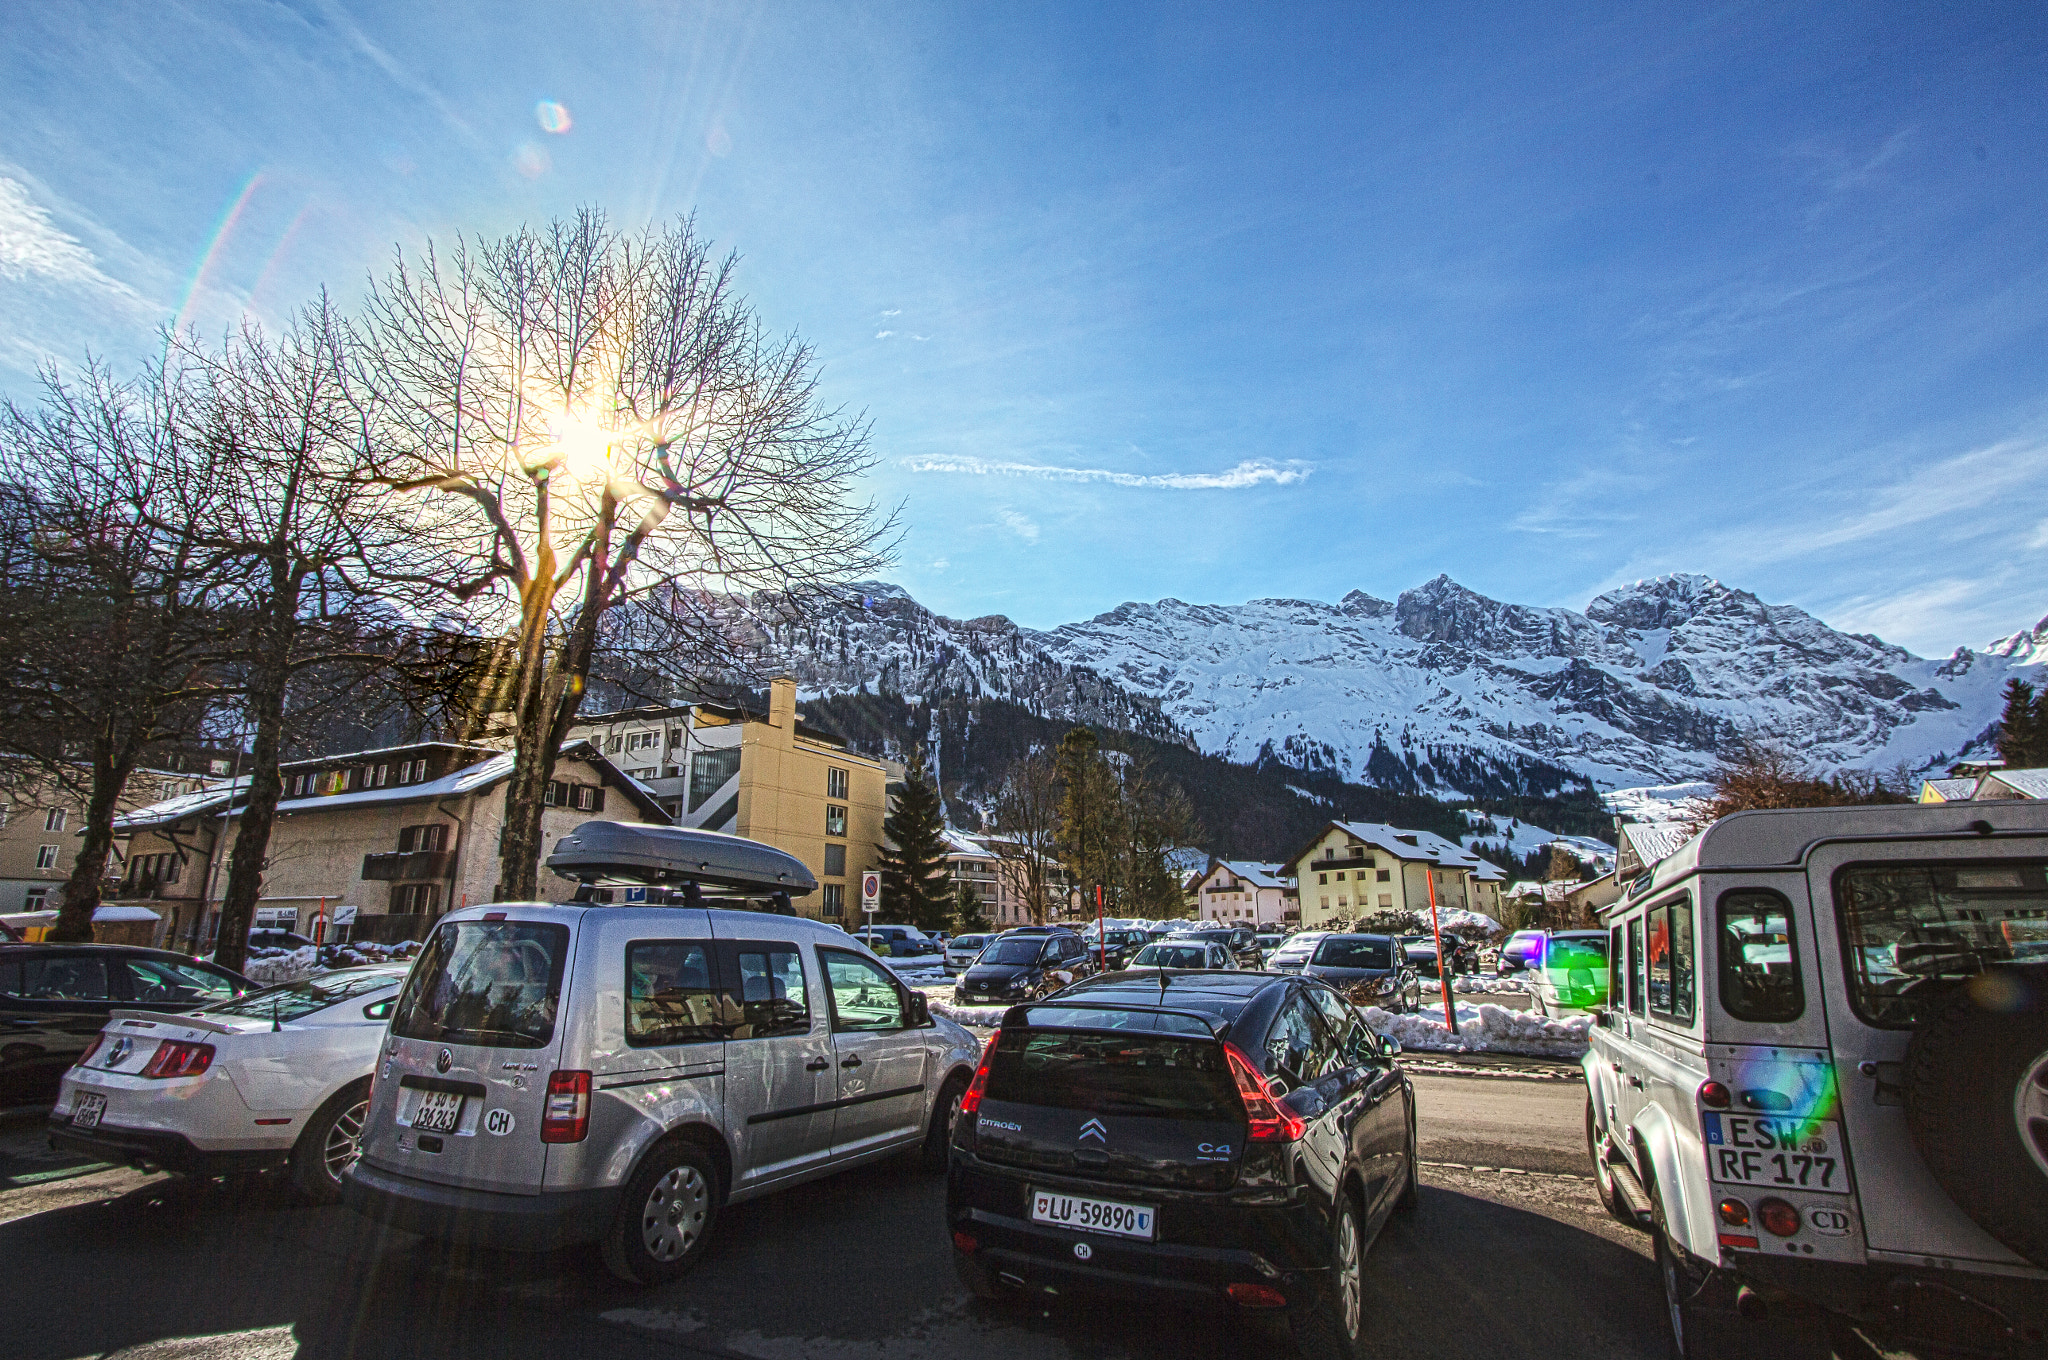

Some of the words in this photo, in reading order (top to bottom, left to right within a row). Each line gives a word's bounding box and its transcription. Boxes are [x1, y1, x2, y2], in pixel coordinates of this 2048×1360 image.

[435, 1093, 448, 1107] SO
[488, 1110, 511, 1133] CH
[979, 1118, 1022, 1131] CITROËN
[1711, 1132, 1718, 1140] D
[1730, 1118, 1797, 1151] ESW
[1197, 1142, 1231, 1154] C4
[1718, 1149, 1762, 1180] RF
[1771, 1153, 1836, 1188] 177
[1811, 1210, 1849, 1229] CD
[1077, 1245, 1088, 1257] CH
